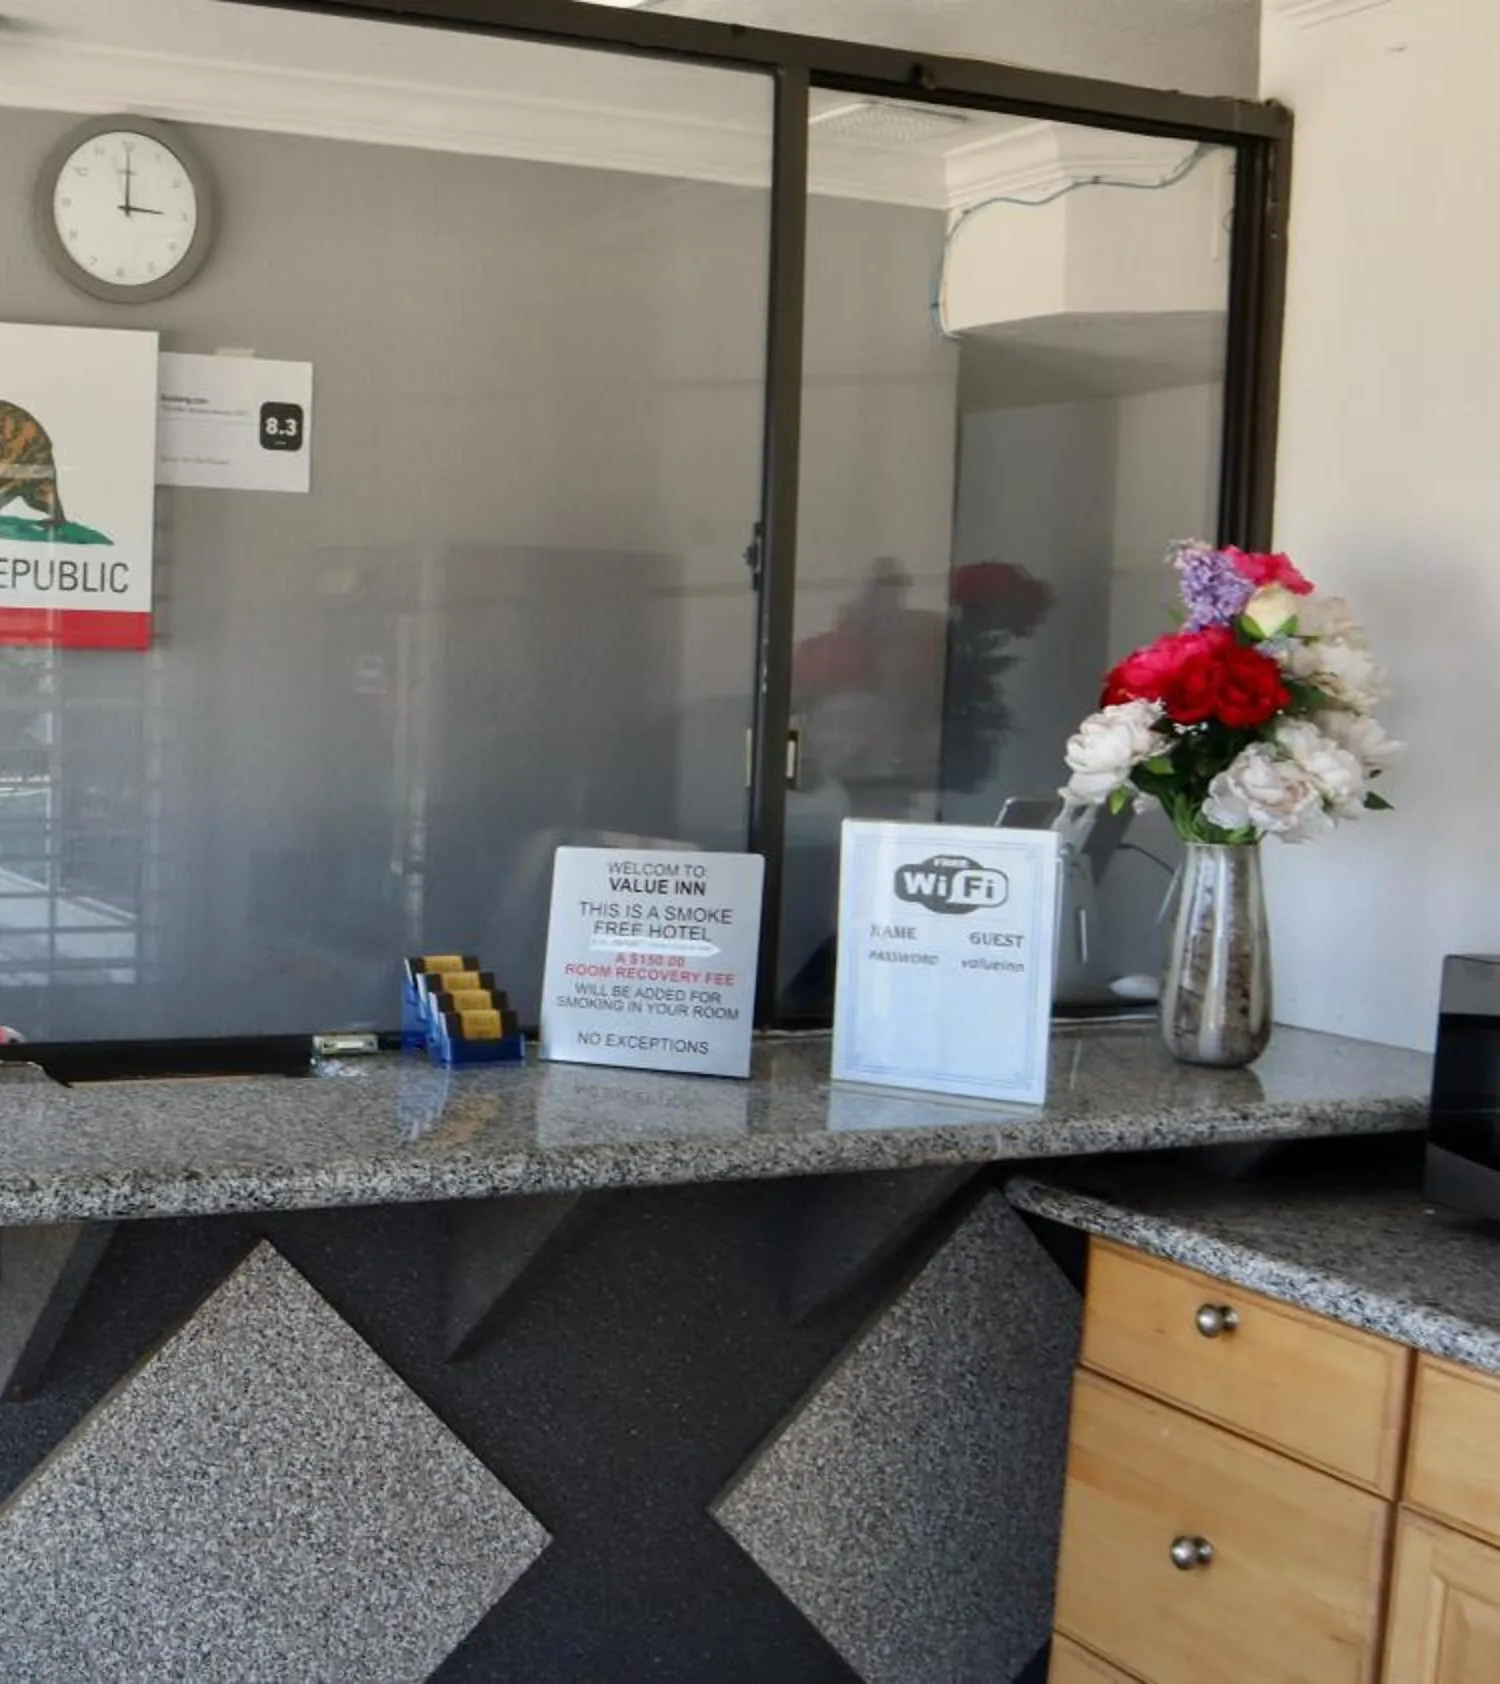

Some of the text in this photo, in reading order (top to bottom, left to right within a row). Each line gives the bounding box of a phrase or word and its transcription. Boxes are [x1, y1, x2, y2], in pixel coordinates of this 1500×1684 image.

[265, 417, 298, 437] 8.3
[608, 861, 680, 877] WELCOM
[609, 877, 706, 896] VALUE INN
[580, 901, 734, 924] THIS IS A SMOKE
[593, 920, 713, 942] FREE HOTEL
[870, 924, 1025, 948] NAME GUEST
[615, 952, 626, 964] A
[564, 963, 736, 986] ROOM RECOVERY FEE
[574, 981, 722, 1005] WILL BE ADDED FOR
[556, 995, 740, 1020] SMOKING IN YOUR ROOM
[577, 1032, 710, 1055] NO EXCEPTIONS
